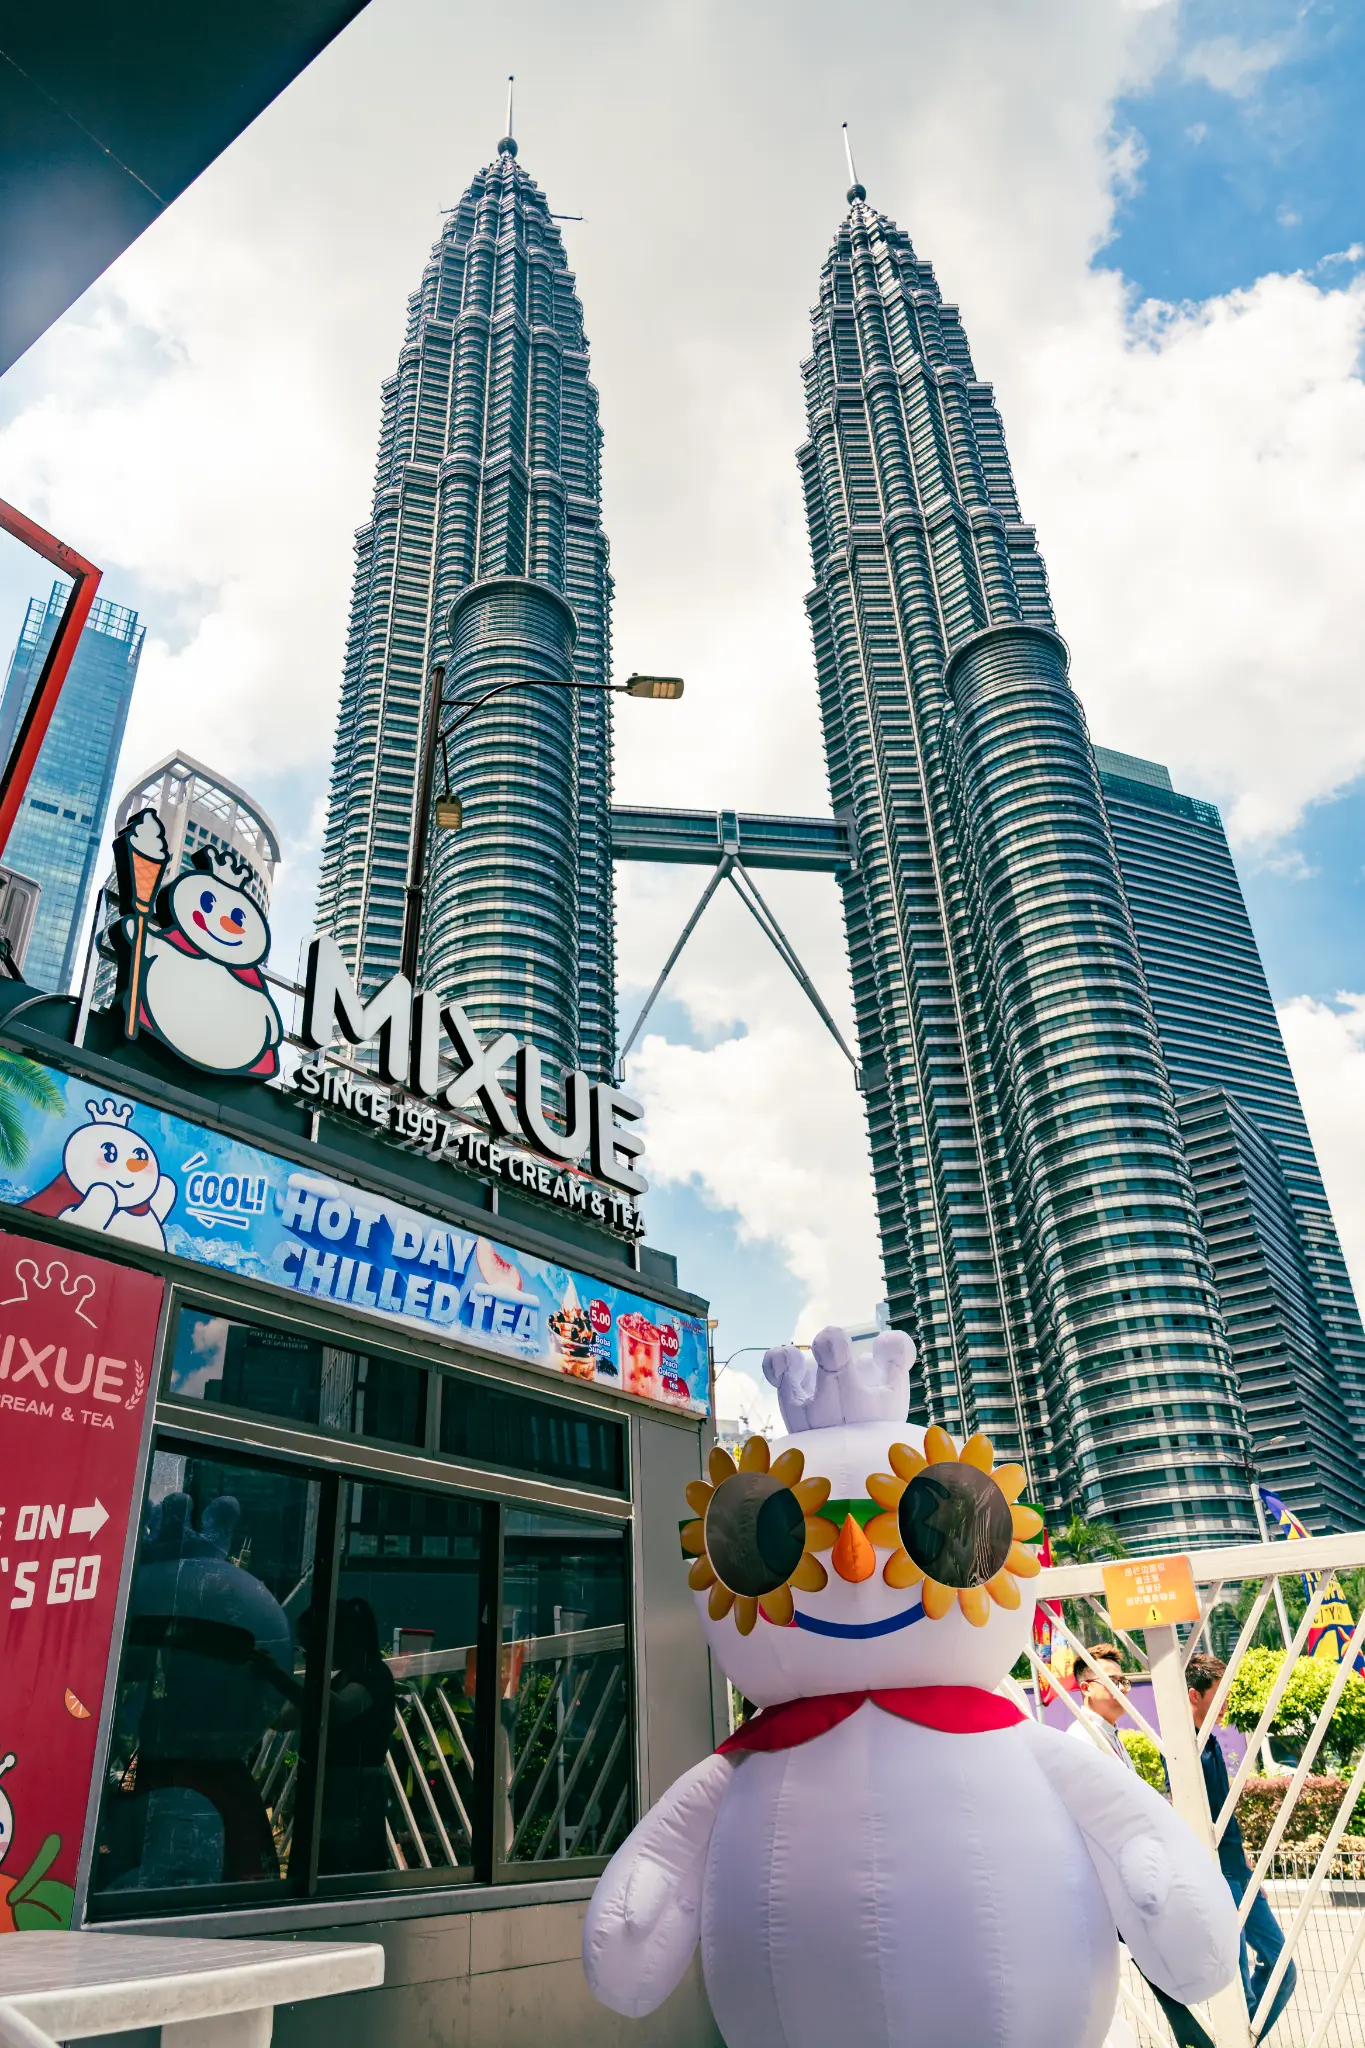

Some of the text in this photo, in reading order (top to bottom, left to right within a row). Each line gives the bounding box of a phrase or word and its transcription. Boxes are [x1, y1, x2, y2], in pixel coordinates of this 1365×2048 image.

[303, 935, 649, 1197] MIXUE
[301, 1066, 649, 1236] SINCE 1997 ICE CREAM & TEA
[188, 1174, 267, 1211] COOL!
[283, 1178, 478, 1275] HOT DAY
[280, 1241, 541, 1341] CHILLED TEA
[590, 1300, 600, 1309] RM
[591, 1309, 611, 1327] 5.00
[660, 1324, 669, 1334] RM
[588, 1344, 611, 1358] Sundae
[595, 1335, 611, 1347] Boba
[660, 1334, 678, 1351] 6.00
[0, 1332, 128, 1404] IXUE
[658, 1366, 678, 1381] Oolong
[662, 1357, 678, 1369] Peach
[668, 1380, 678, 1390] Tea
[0, 1394, 115, 1430] REAM & TEA
[14, 1503, 66, 1542] ON
[46, 1554, 102, 1605] GO
